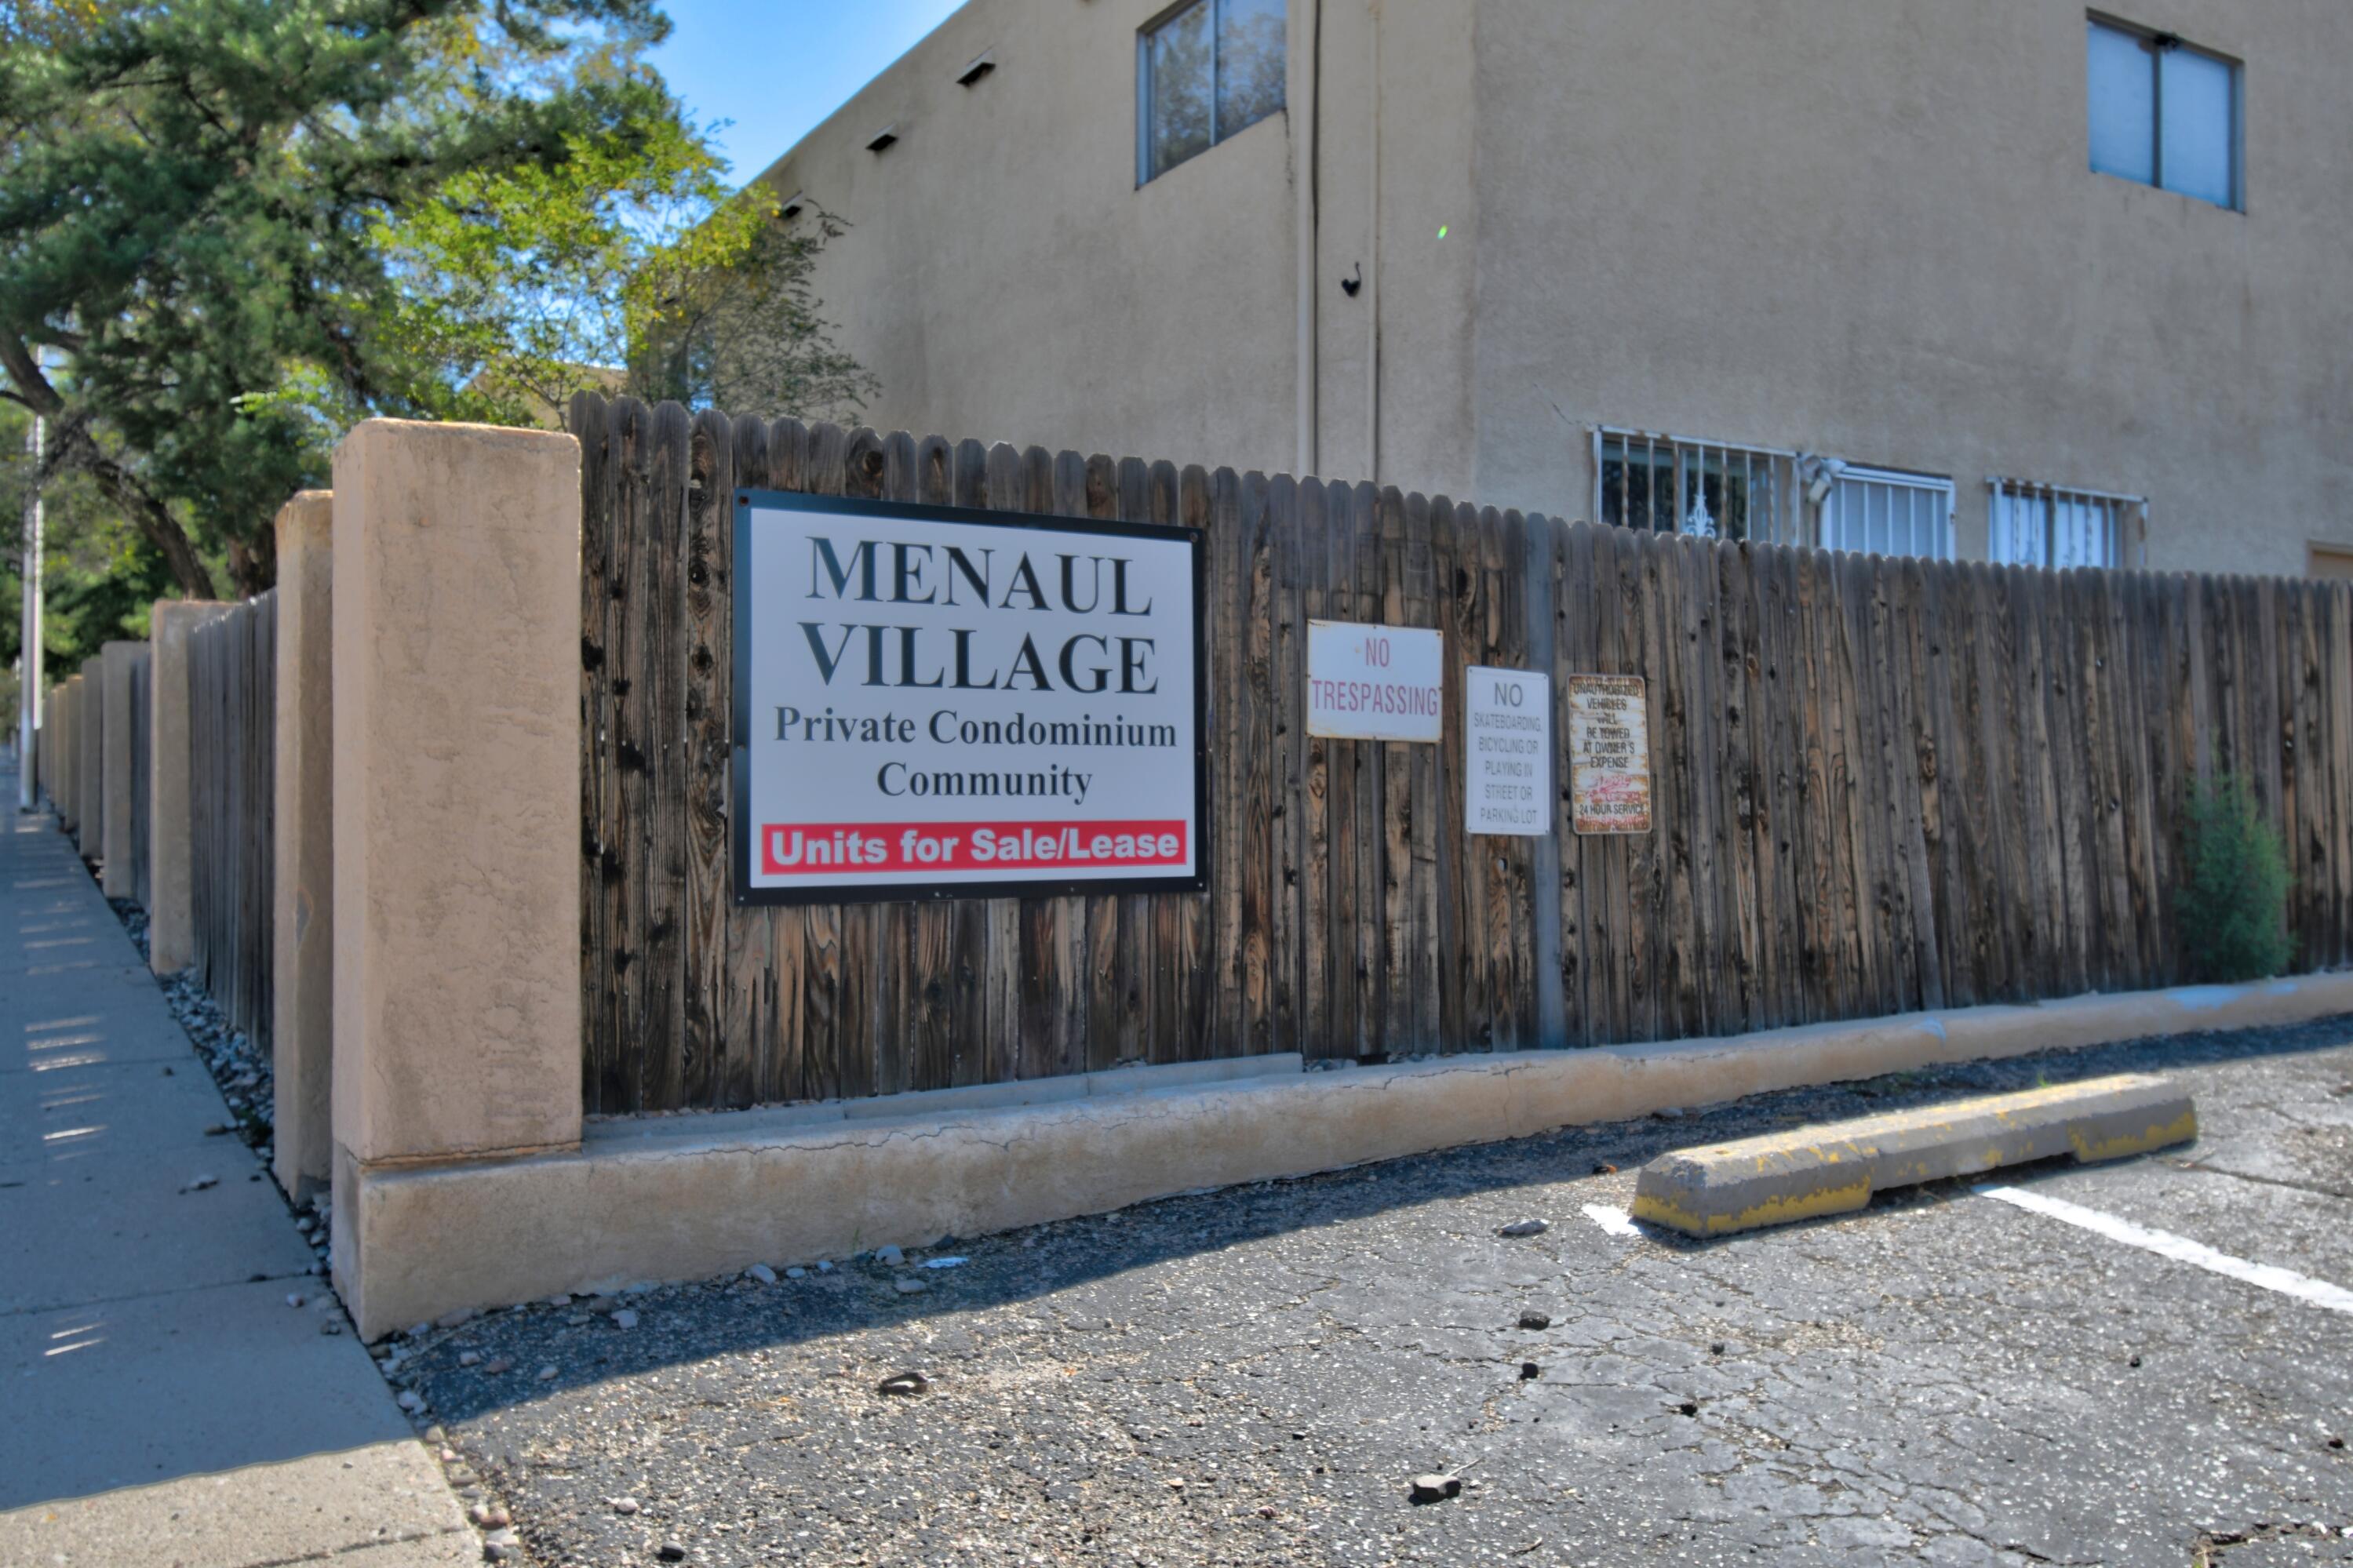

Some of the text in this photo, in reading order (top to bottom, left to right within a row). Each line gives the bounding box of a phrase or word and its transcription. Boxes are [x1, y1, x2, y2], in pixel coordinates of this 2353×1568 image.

[804, 536, 1153, 617] MENAUL
[797, 621, 1159, 695] VILLAGE
[1365, 637, 1390, 668] NO
[1312, 679, 1439, 716] TRESPASSING
[1494, 682, 1524, 708] NO
[1587, 697, 1627, 711] VEHICLES
[774, 706, 1177, 747] Private Condominium
[1586, 726, 1630, 740] BE TOWED
[1478, 736, 1539, 755] BICYCLING OR
[1583, 740, 1593, 754] AT
[1485, 759, 1533, 778] PLAYING IN
[1590, 756, 1629, 769] EXPENSE
[877, 762, 1092, 805] Community
[1485, 784, 1533, 801] STREET OR
[1480, 806, 1538, 824] PARKING LOT
[1579, 803, 1645, 816] 24 HOUR SERVICE
[771, 828, 1179, 865] Units for Sale/Lease
